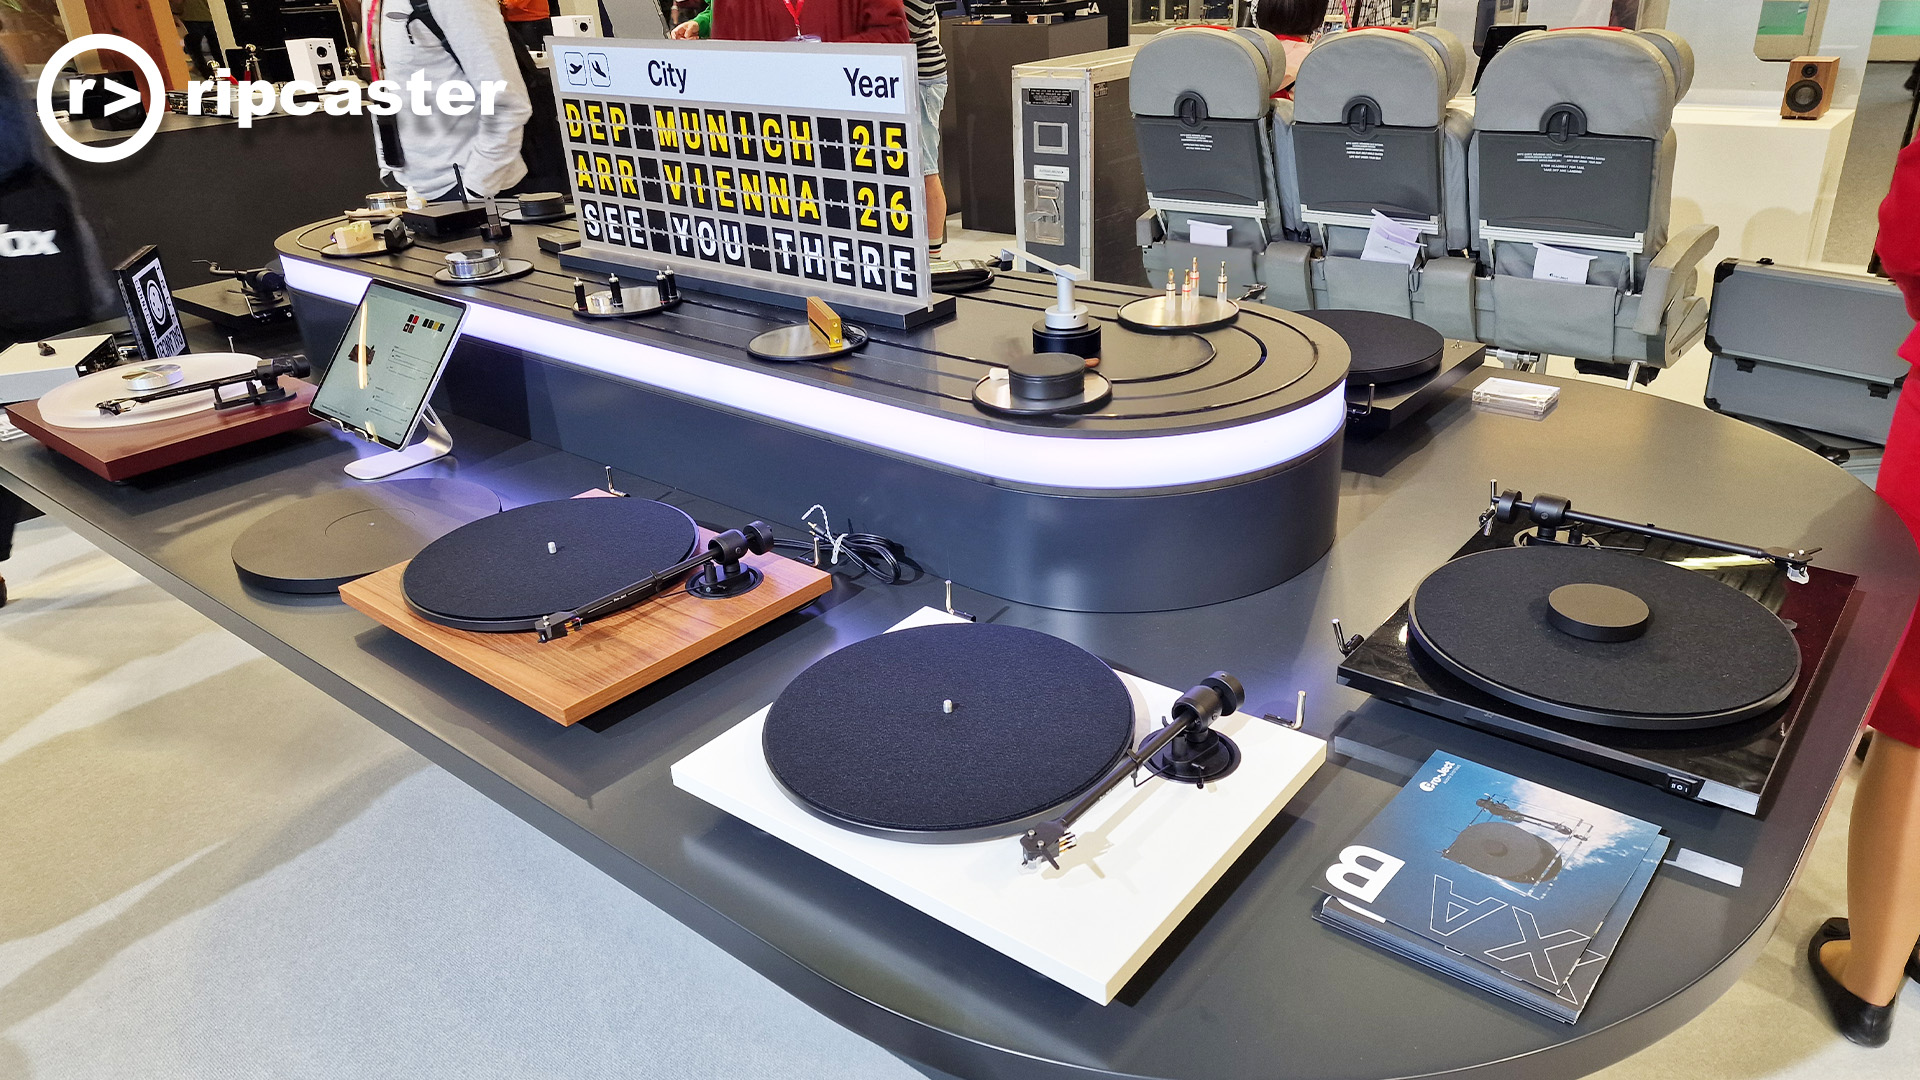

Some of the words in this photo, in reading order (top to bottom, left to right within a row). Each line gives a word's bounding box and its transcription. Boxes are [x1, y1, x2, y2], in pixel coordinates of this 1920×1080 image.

[647, 59, 687, 94] City
[843, 67, 900, 99] Year
[564, 103, 626, 142] DEP
[655, 110, 813, 162] MUNICH
[852, 125, 904, 170] 25
[577, 154, 638, 194] ARR
[663, 164, 820, 220] VIENNA
[857, 187, 909, 231] 26
[585, 203, 645, 244] SEE
[671, 216, 742, 260] YOU
[775, 232, 914, 290] THERE
[1419, 761, 1455, 792] Pro-Ject
[1325, 845, 1406, 904] B
